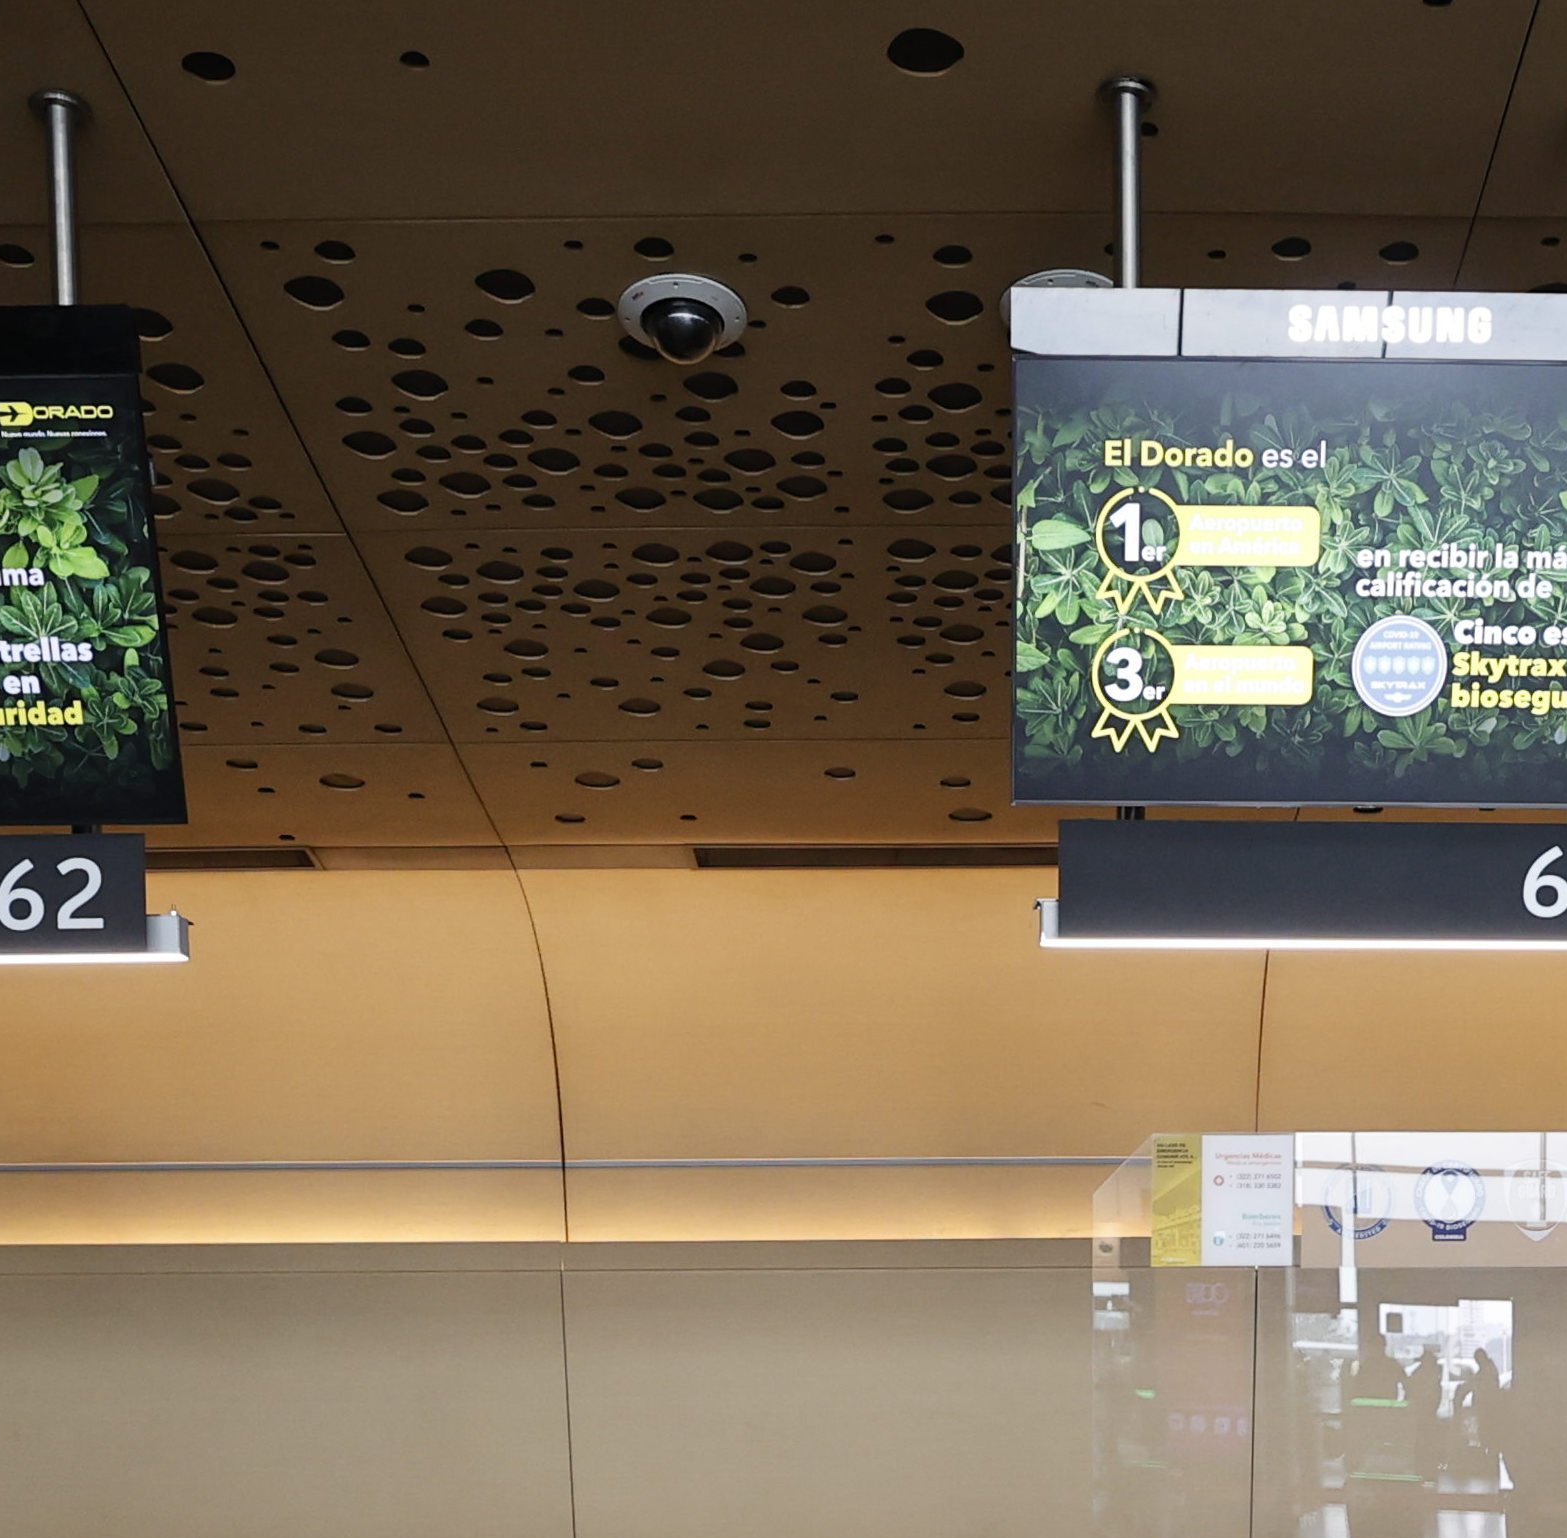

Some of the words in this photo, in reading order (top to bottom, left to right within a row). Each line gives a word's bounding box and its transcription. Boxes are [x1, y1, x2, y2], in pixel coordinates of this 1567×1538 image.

[1288, 305, 1492, 343] SAMSUNG
[1104, 439, 1131, 467] El
[1140, 439, 1254, 467] Dorado
[1262, 448, 1292, 468] es
[1301, 440, 1326, 468] el
[1357, 548, 1391, 568] en
[1399, 543, 1488, 568] recibir
[1494, 543, 1519, 569] la
[1355, 572, 1510, 599] calificación
[1517, 573, 1553, 599] de
[1453, 619, 1537, 645] Cinco
[1452, 651, 1567, 683] Skytrax
[3, 674, 41, 694] en
